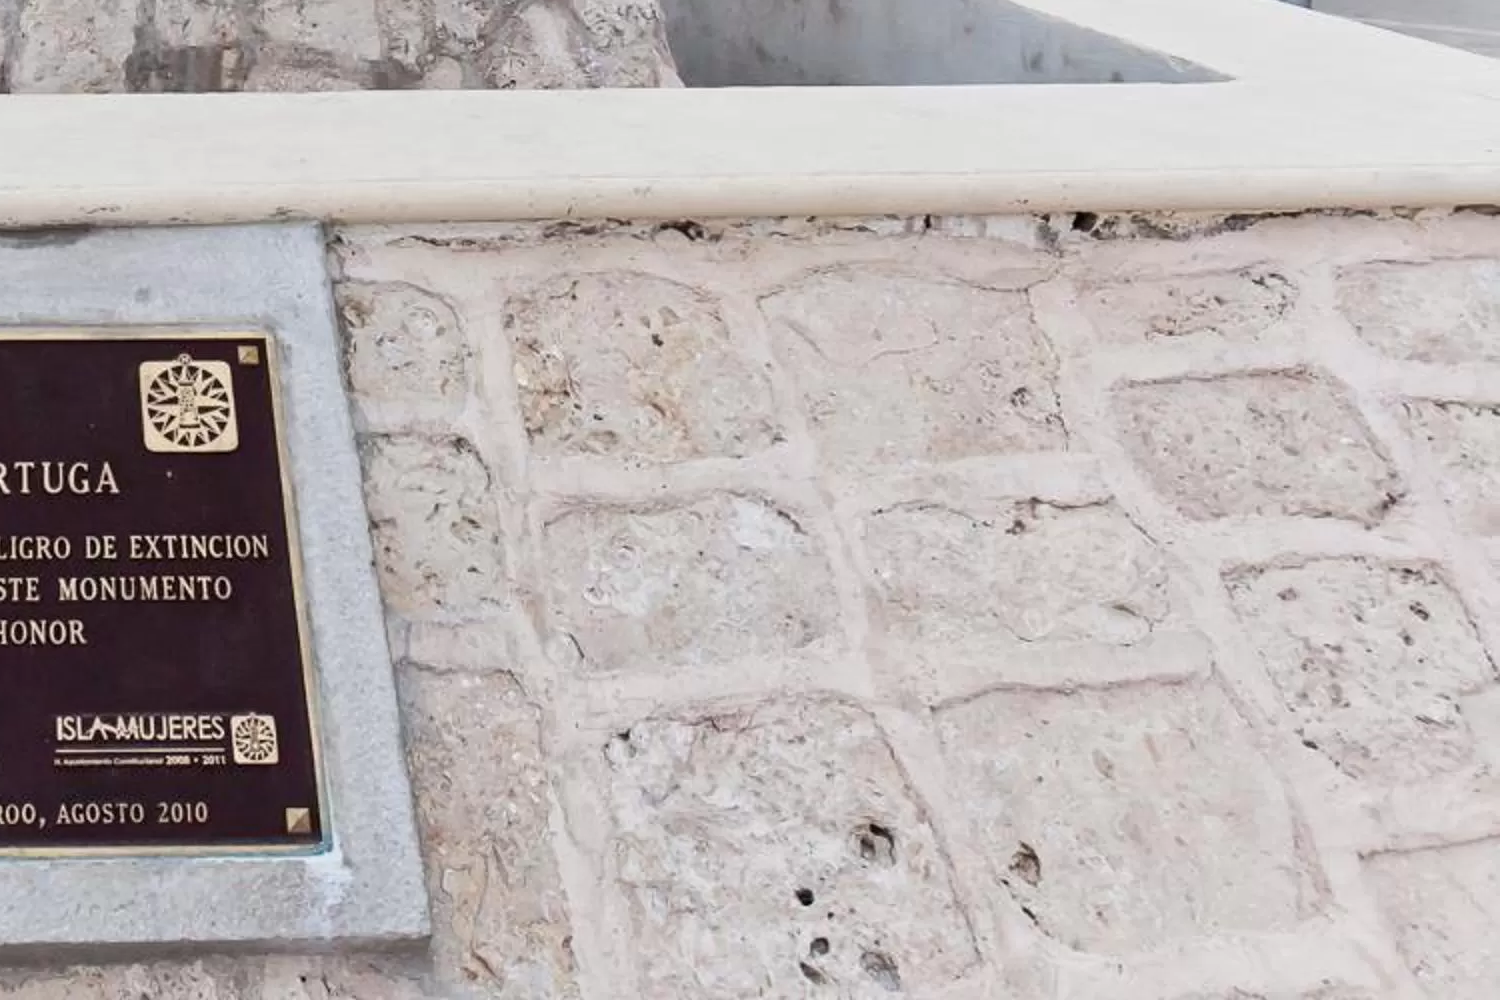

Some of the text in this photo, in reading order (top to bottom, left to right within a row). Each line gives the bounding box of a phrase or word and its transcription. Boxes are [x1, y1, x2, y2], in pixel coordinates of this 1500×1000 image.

[85, 535, 117, 559] DE
[129, 534, 269, 559] EXTINCION
[58, 575, 232, 601] MONUMENTO
[55, 714, 226, 742] ISLA MUJERES
[56, 802, 145, 825] AGOSTO
[158, 801, 208, 823] 2010
